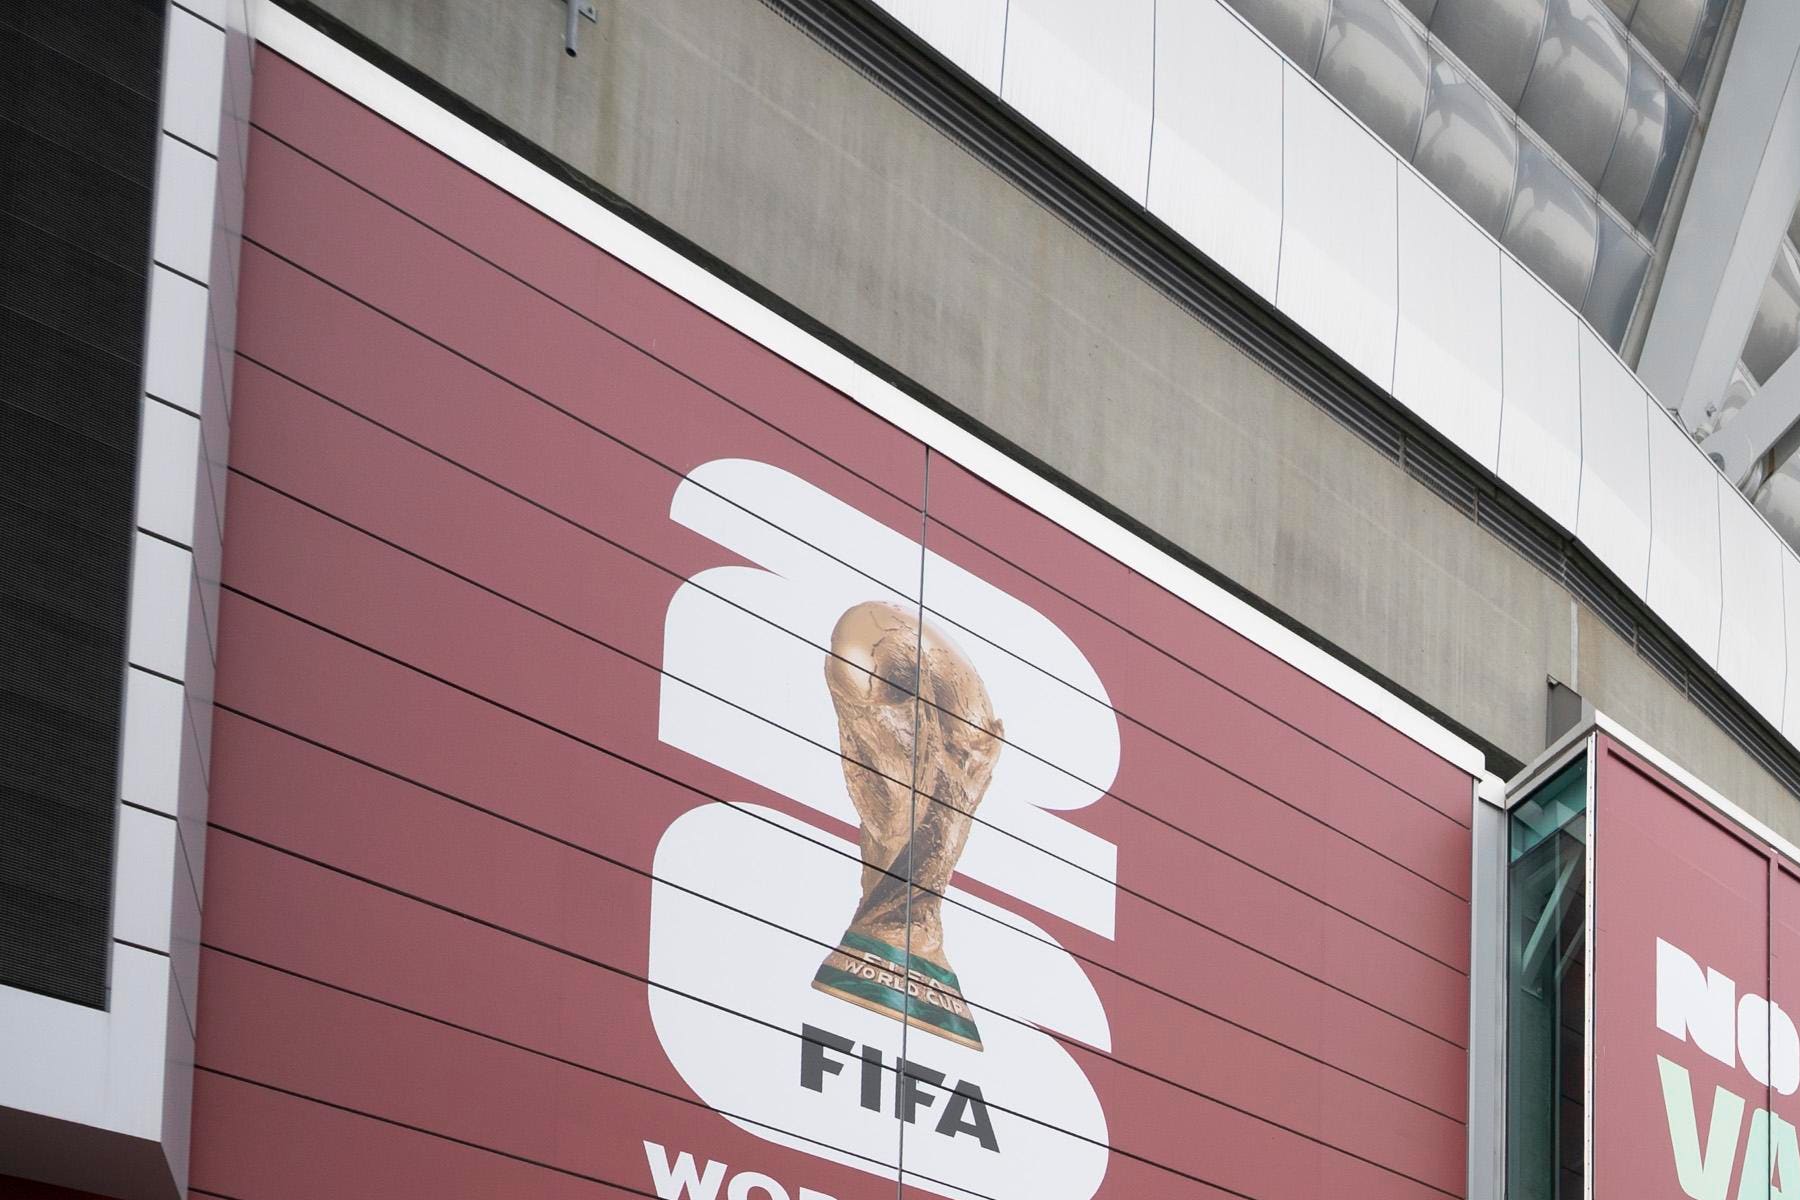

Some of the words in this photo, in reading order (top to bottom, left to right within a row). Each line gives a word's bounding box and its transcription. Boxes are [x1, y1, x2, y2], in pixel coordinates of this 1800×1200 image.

[844, 958, 920, 997] WORLD
[926, 988, 965, 1016] CUP
[799, 1022, 1001, 1154] FIFA
